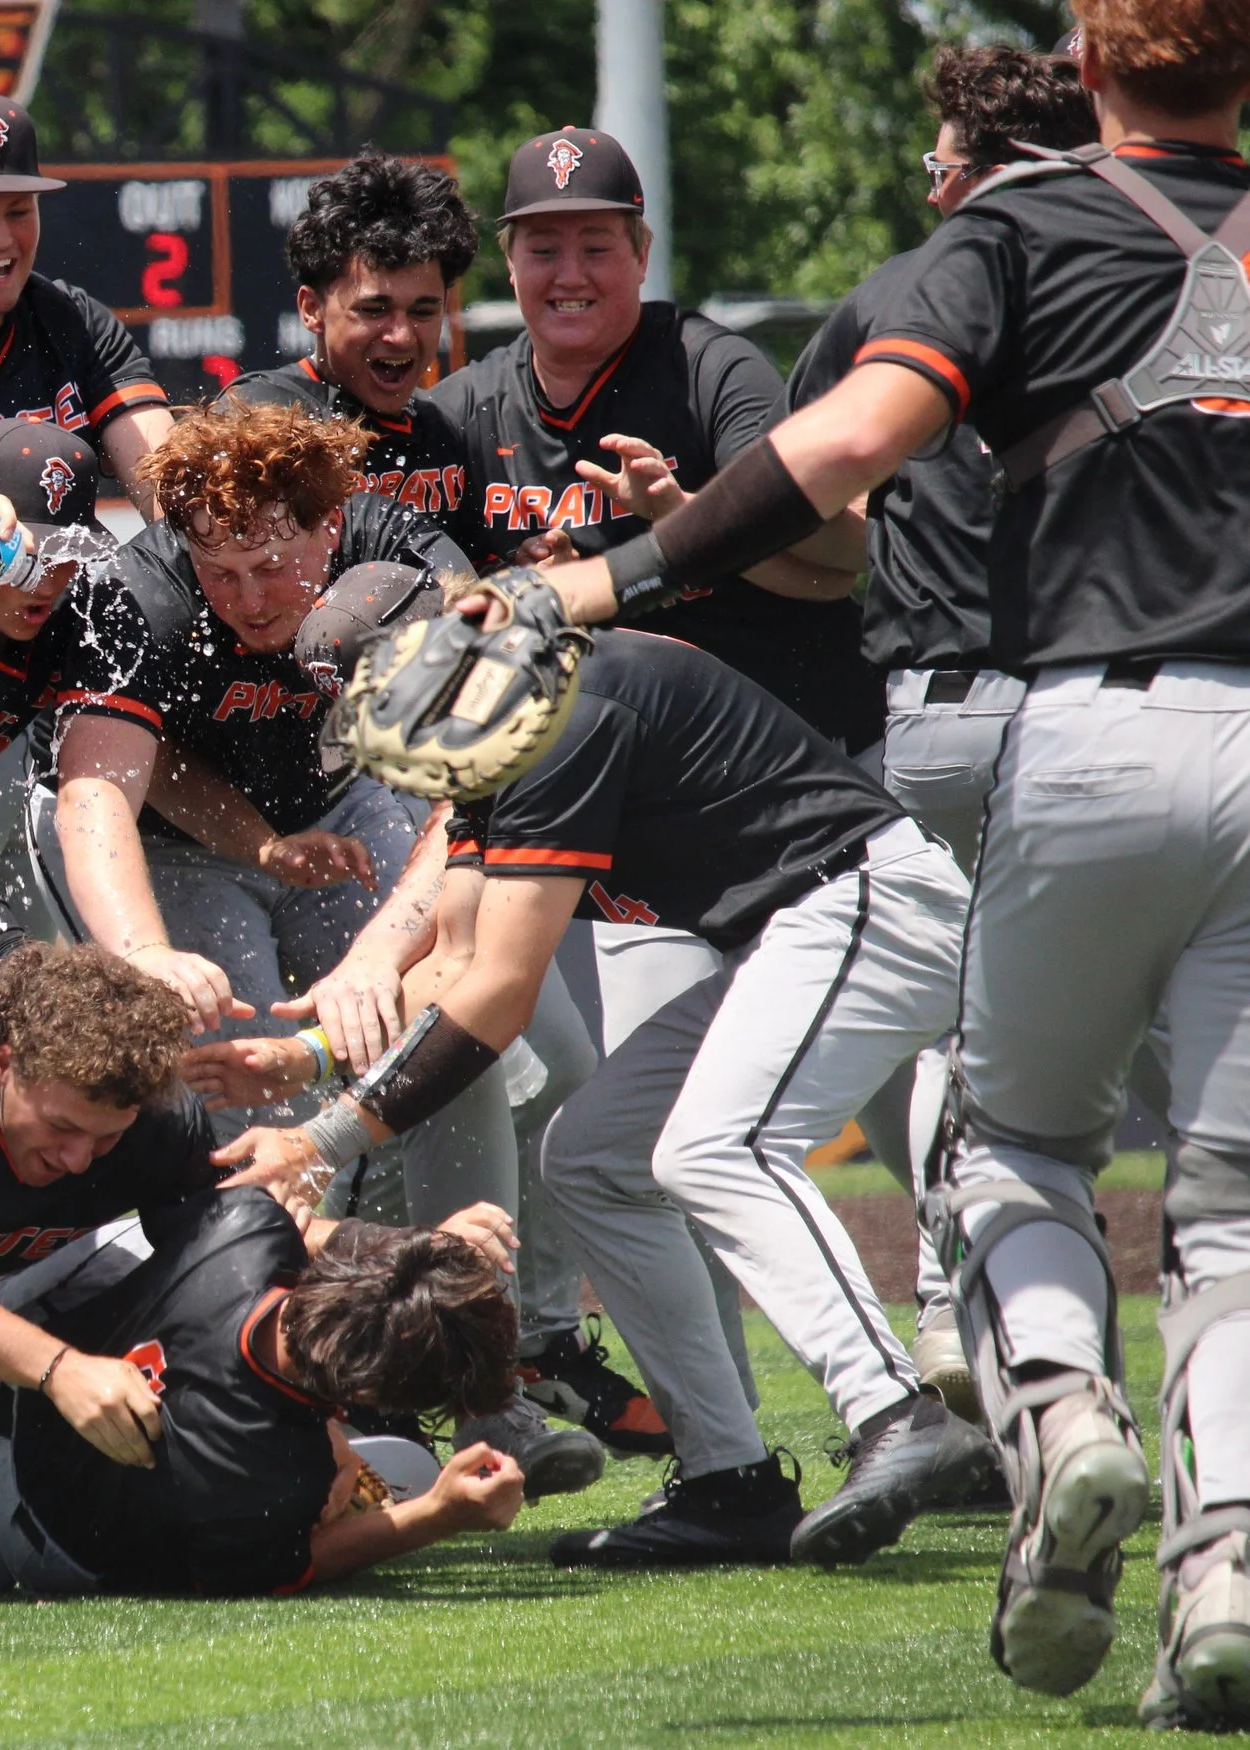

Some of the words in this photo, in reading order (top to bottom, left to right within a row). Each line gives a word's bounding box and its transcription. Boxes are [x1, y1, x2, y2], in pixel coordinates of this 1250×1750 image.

[118, 180, 207, 233] OUT
[141, 232, 190, 308] 2
[149, 313, 246, 360] RUNS
